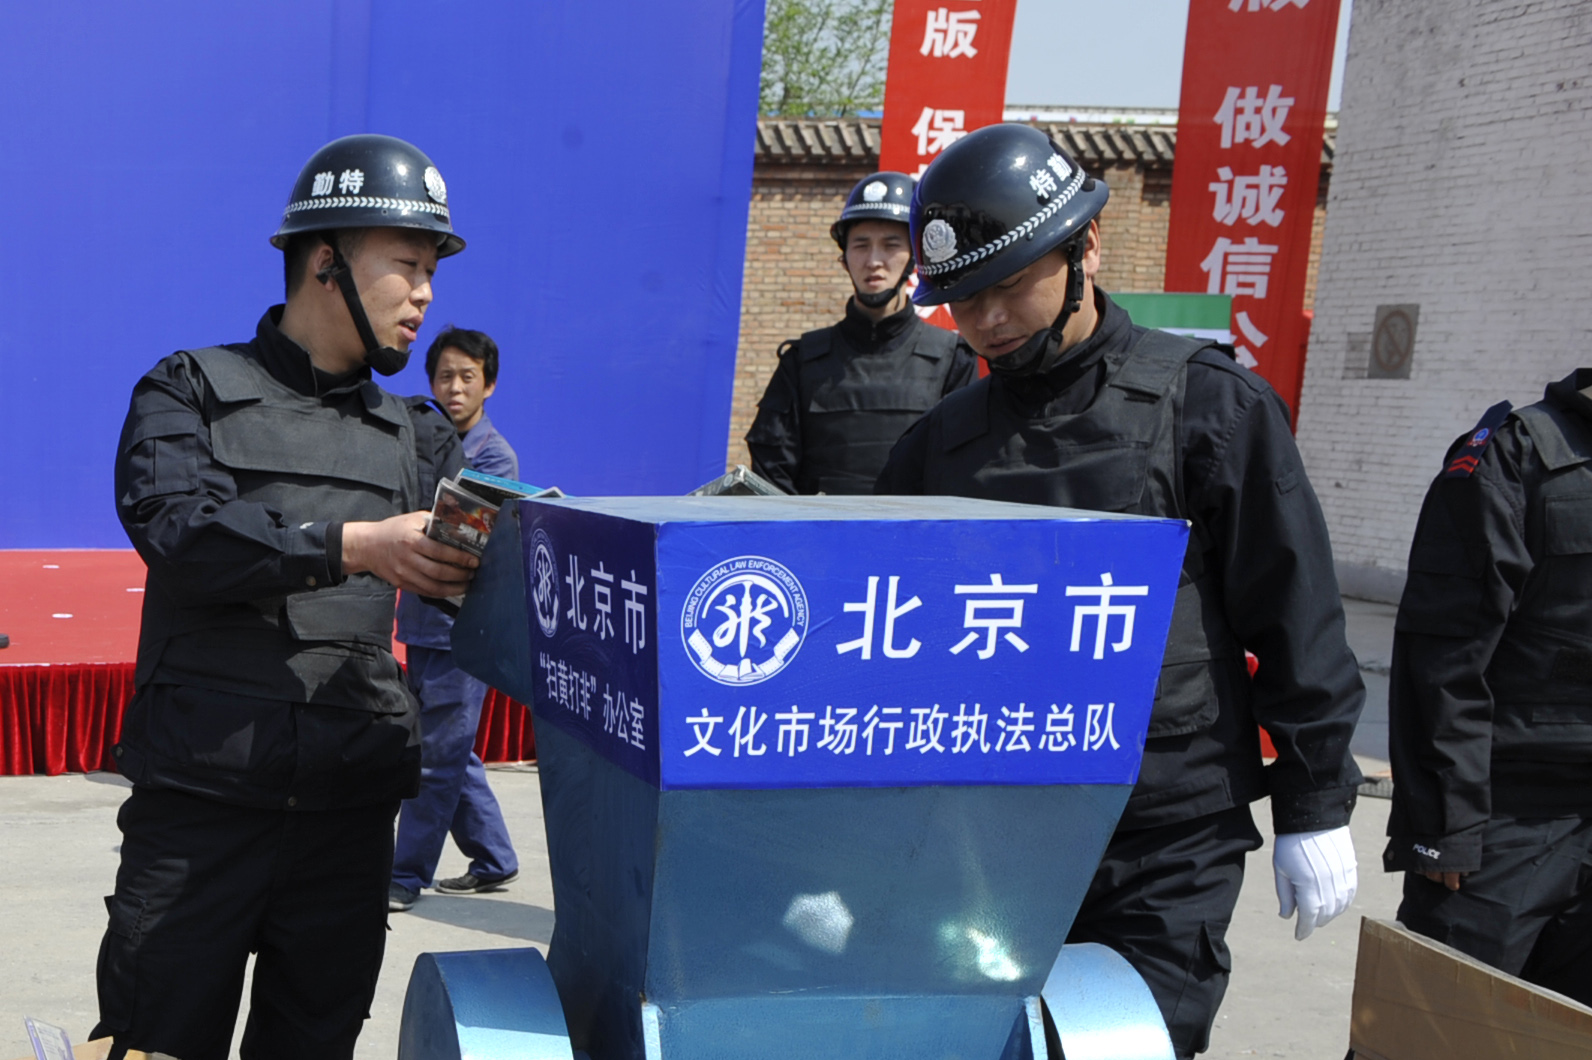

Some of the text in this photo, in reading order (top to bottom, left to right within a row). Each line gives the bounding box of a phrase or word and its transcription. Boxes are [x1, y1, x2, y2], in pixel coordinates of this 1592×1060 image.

[729, 560, 747, 571] LAW
[565, 554, 648, 655] 北京市
[835, 572, 1150, 660] 北京市
[683, 702, 1121, 758] 文化市场行政执法总队
